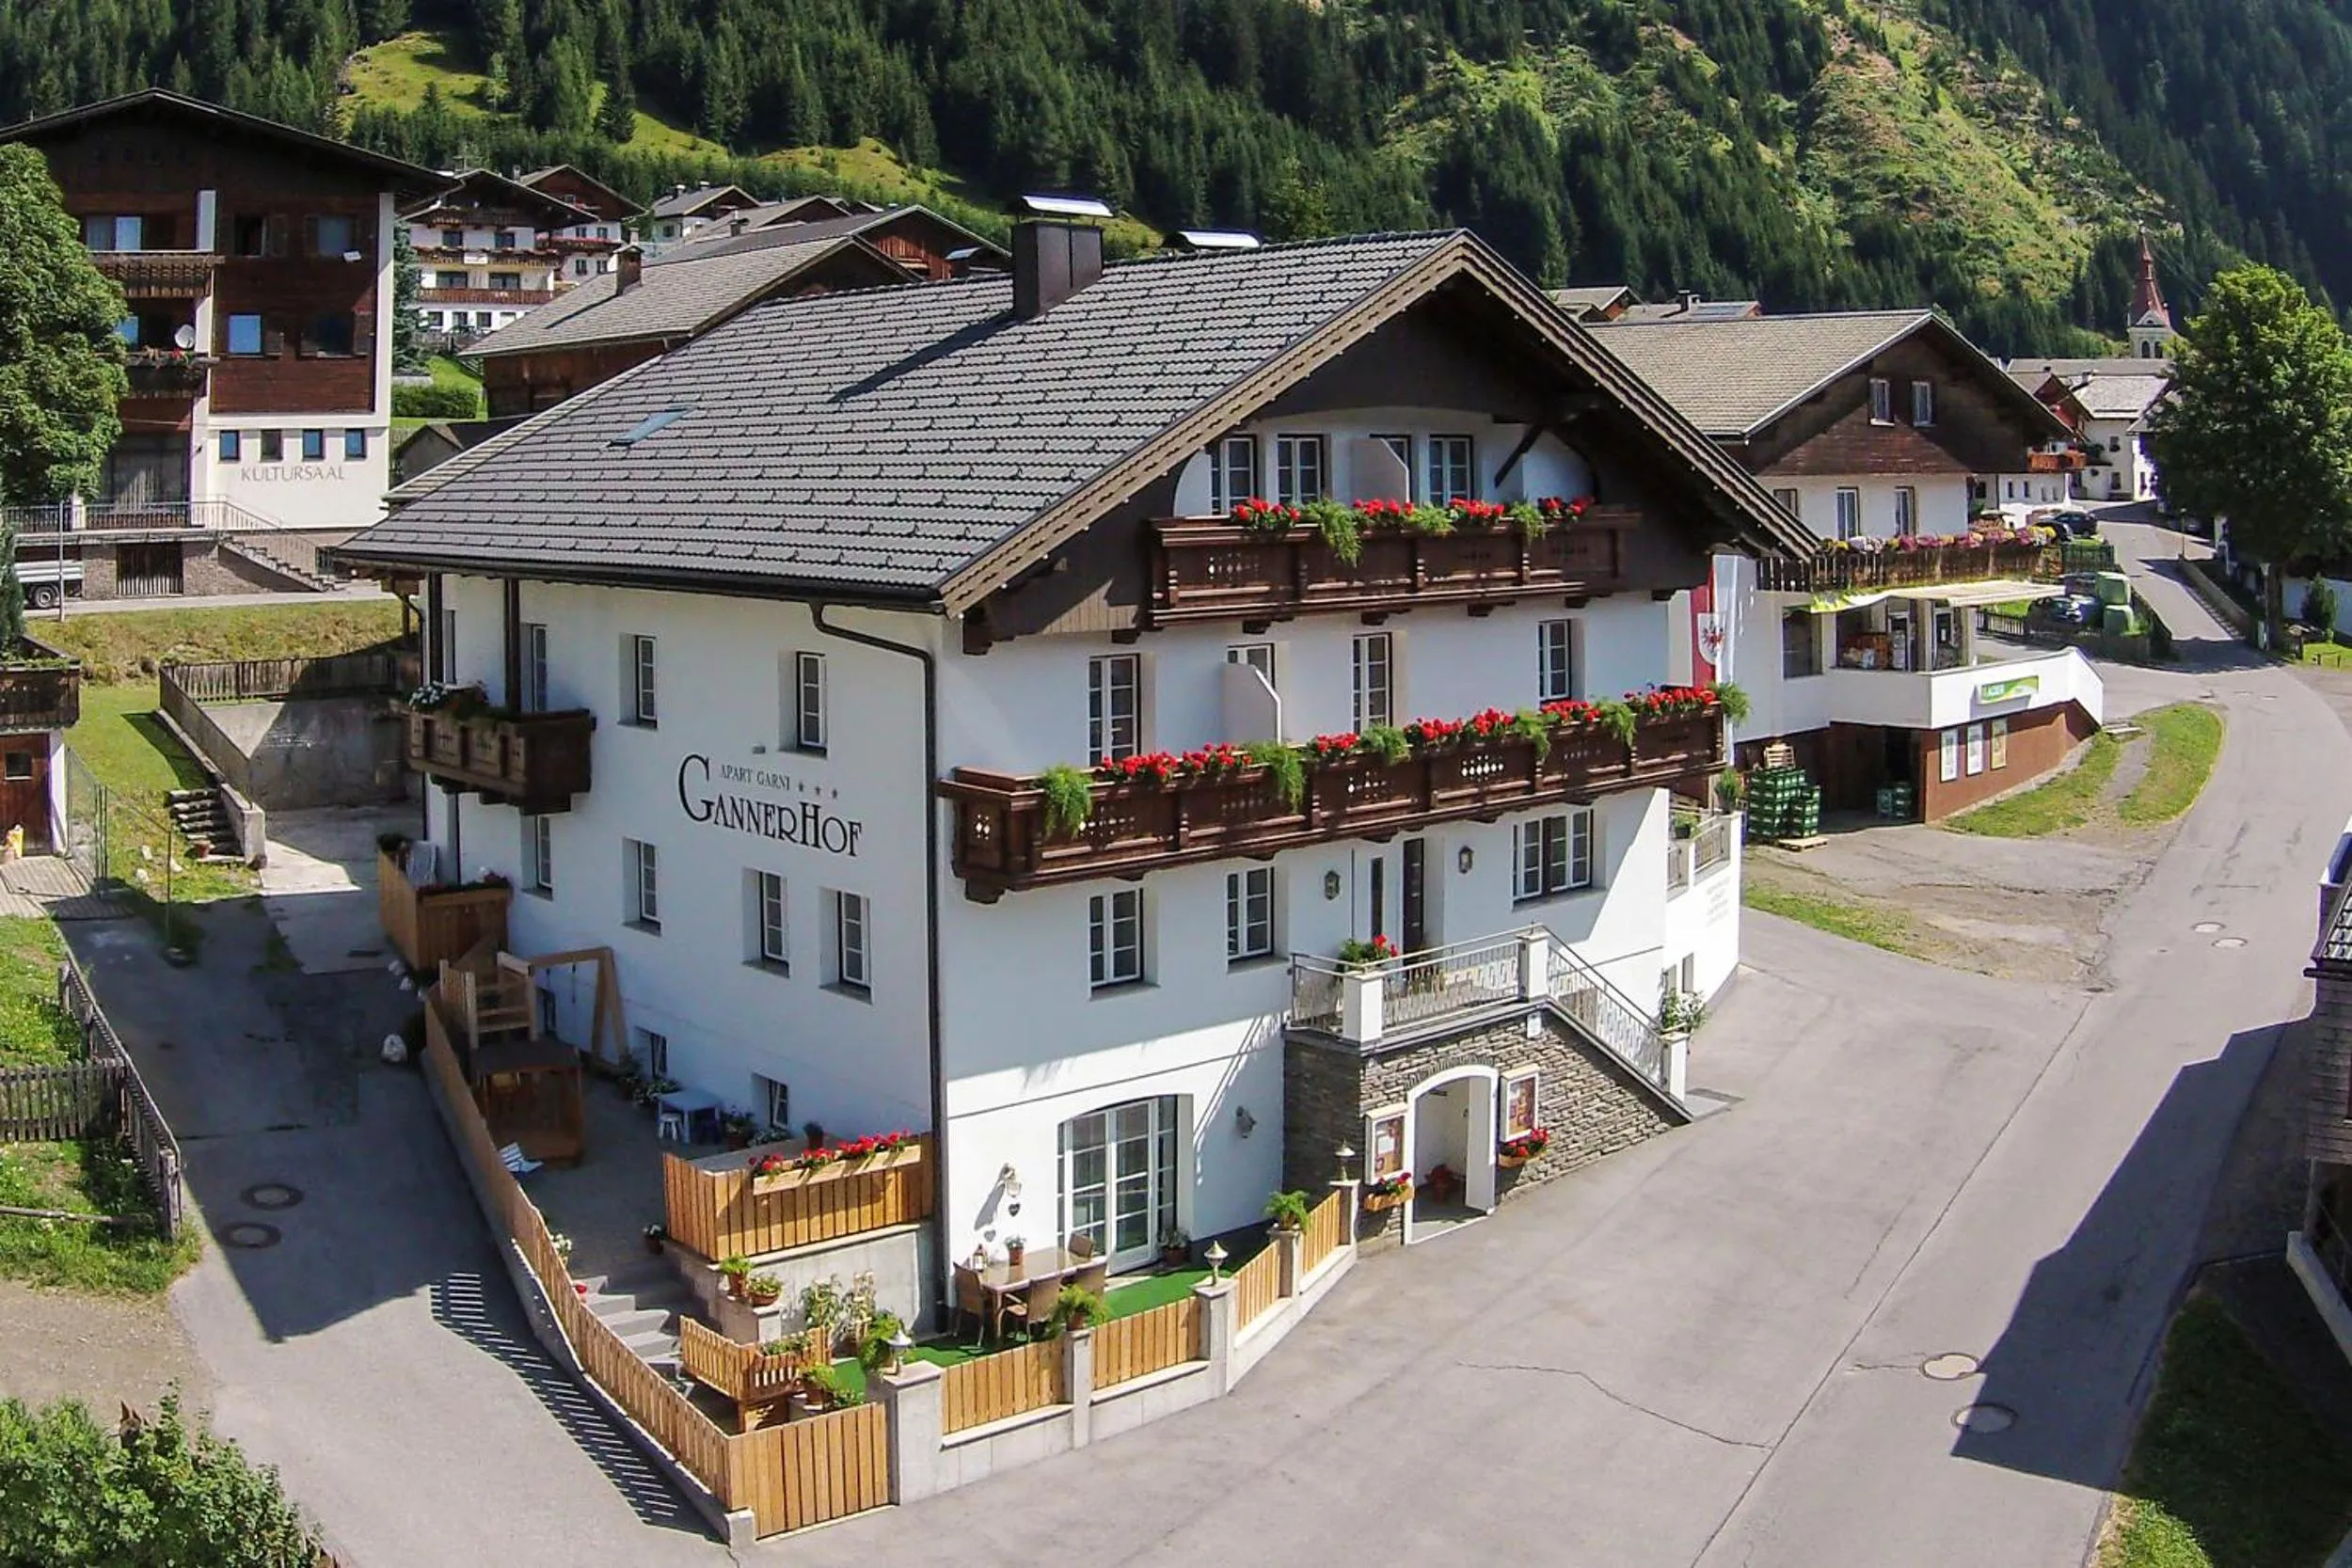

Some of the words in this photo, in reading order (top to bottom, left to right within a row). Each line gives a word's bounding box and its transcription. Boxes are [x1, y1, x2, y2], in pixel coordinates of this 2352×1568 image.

[241, 466, 345, 482] KULTURSAAL
[720, 764, 753, 784] APART
[756, 770, 790, 791] GARNI
